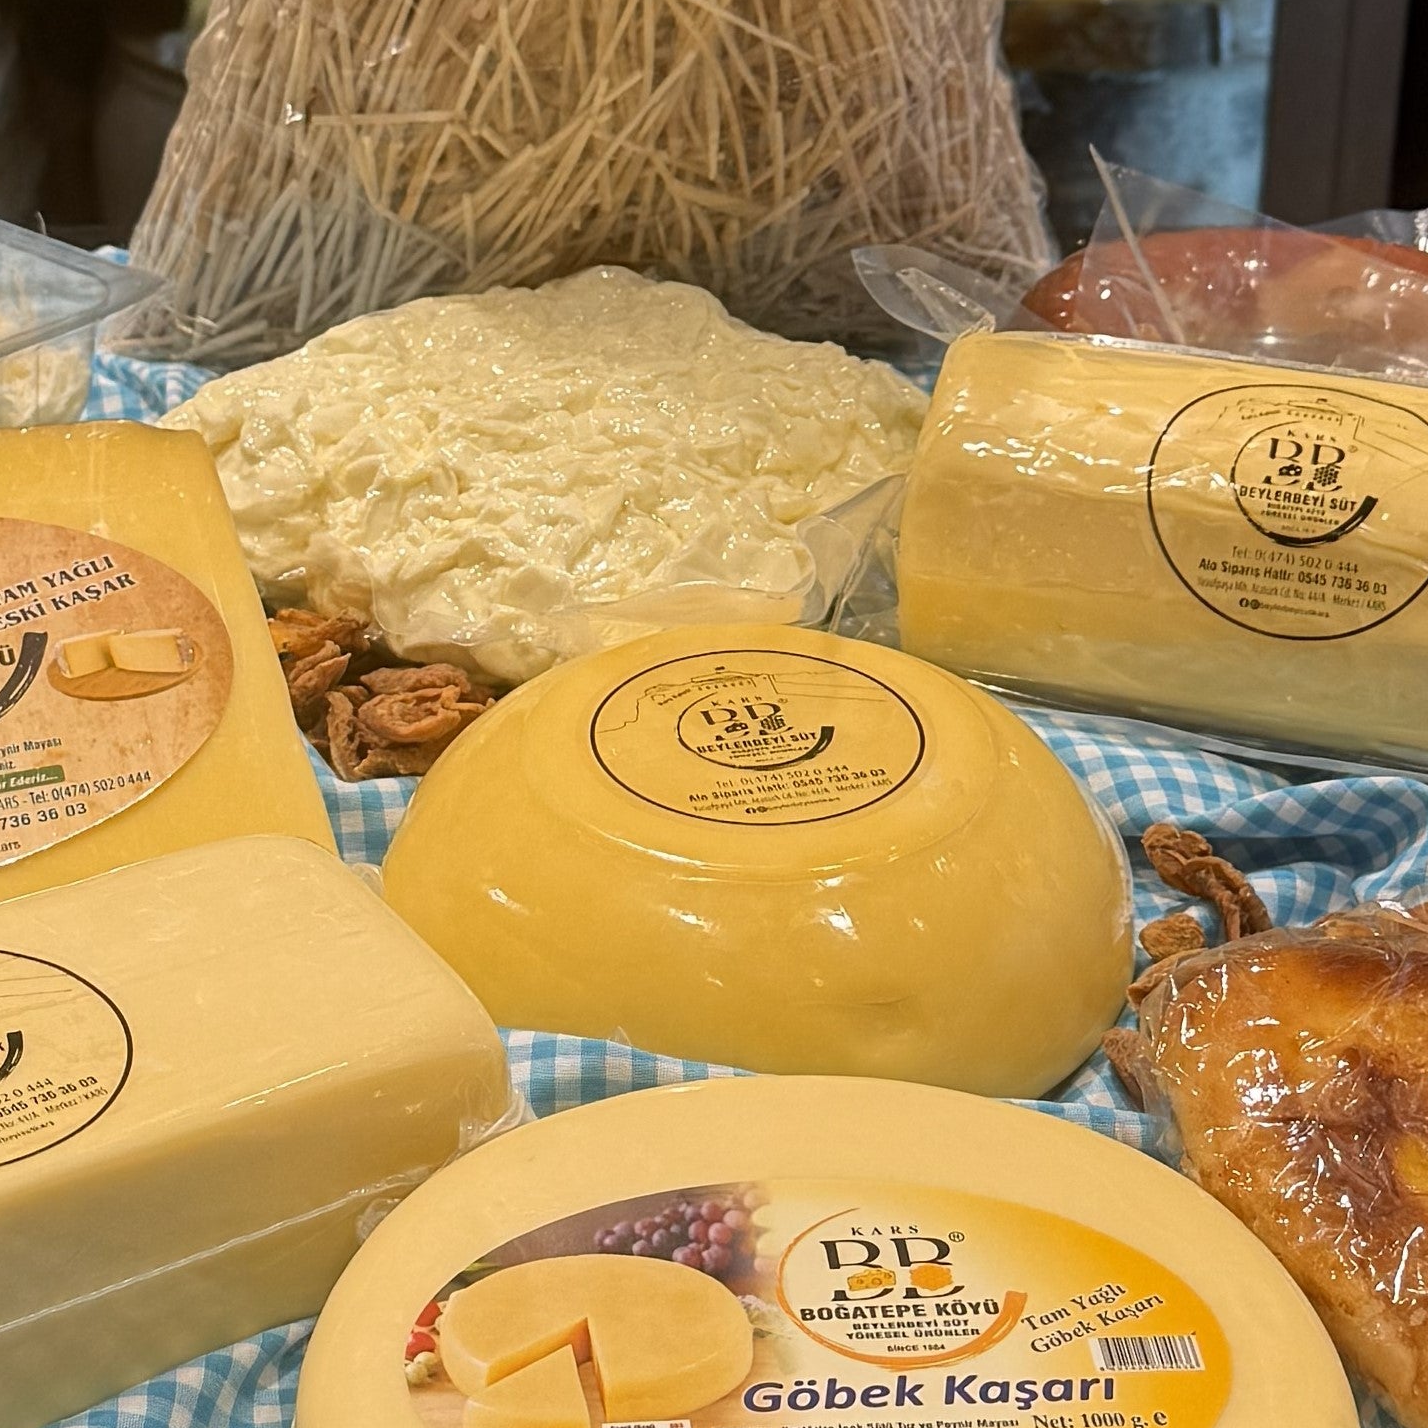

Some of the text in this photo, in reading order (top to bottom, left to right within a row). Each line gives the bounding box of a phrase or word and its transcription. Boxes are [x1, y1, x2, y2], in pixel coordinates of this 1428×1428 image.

[1239, 486, 1357, 511] BEYLERBEYİ SÜT
[42, 556, 114, 588] YAĞLI
[1198, 558, 1217, 570] Alo
[1298, 571, 1327, 585] 0545
[1355, 579, 1369, 592] 36
[51, 574, 136, 610] KAŞAR
[29, 791, 50, 805] Tel:
[53, 782, 91, 800] 0(474)
[93, 778, 113, 793] 502
[128, 771, 151, 785] 444
[38, 808, 58, 822] 36
[66, 803, 87, 816] 03
[851, 1225, 919, 1236] KARS
[800, 1299, 999, 1321] BOĞATEPE KÖYÜ
[1021, 1284, 1126, 1331] Tam Yağlı
[1030, 1295, 1163, 1352] Göbek Kaşarı
[846, 1328, 980, 1339] YÖRESEL ÜRÜNLER
[744, 1374, 1114, 1412] Göbek Kaşarı
[1033, 1415, 1074, 1428] Net:
[1082, 1413, 1125, 1428] 1000
